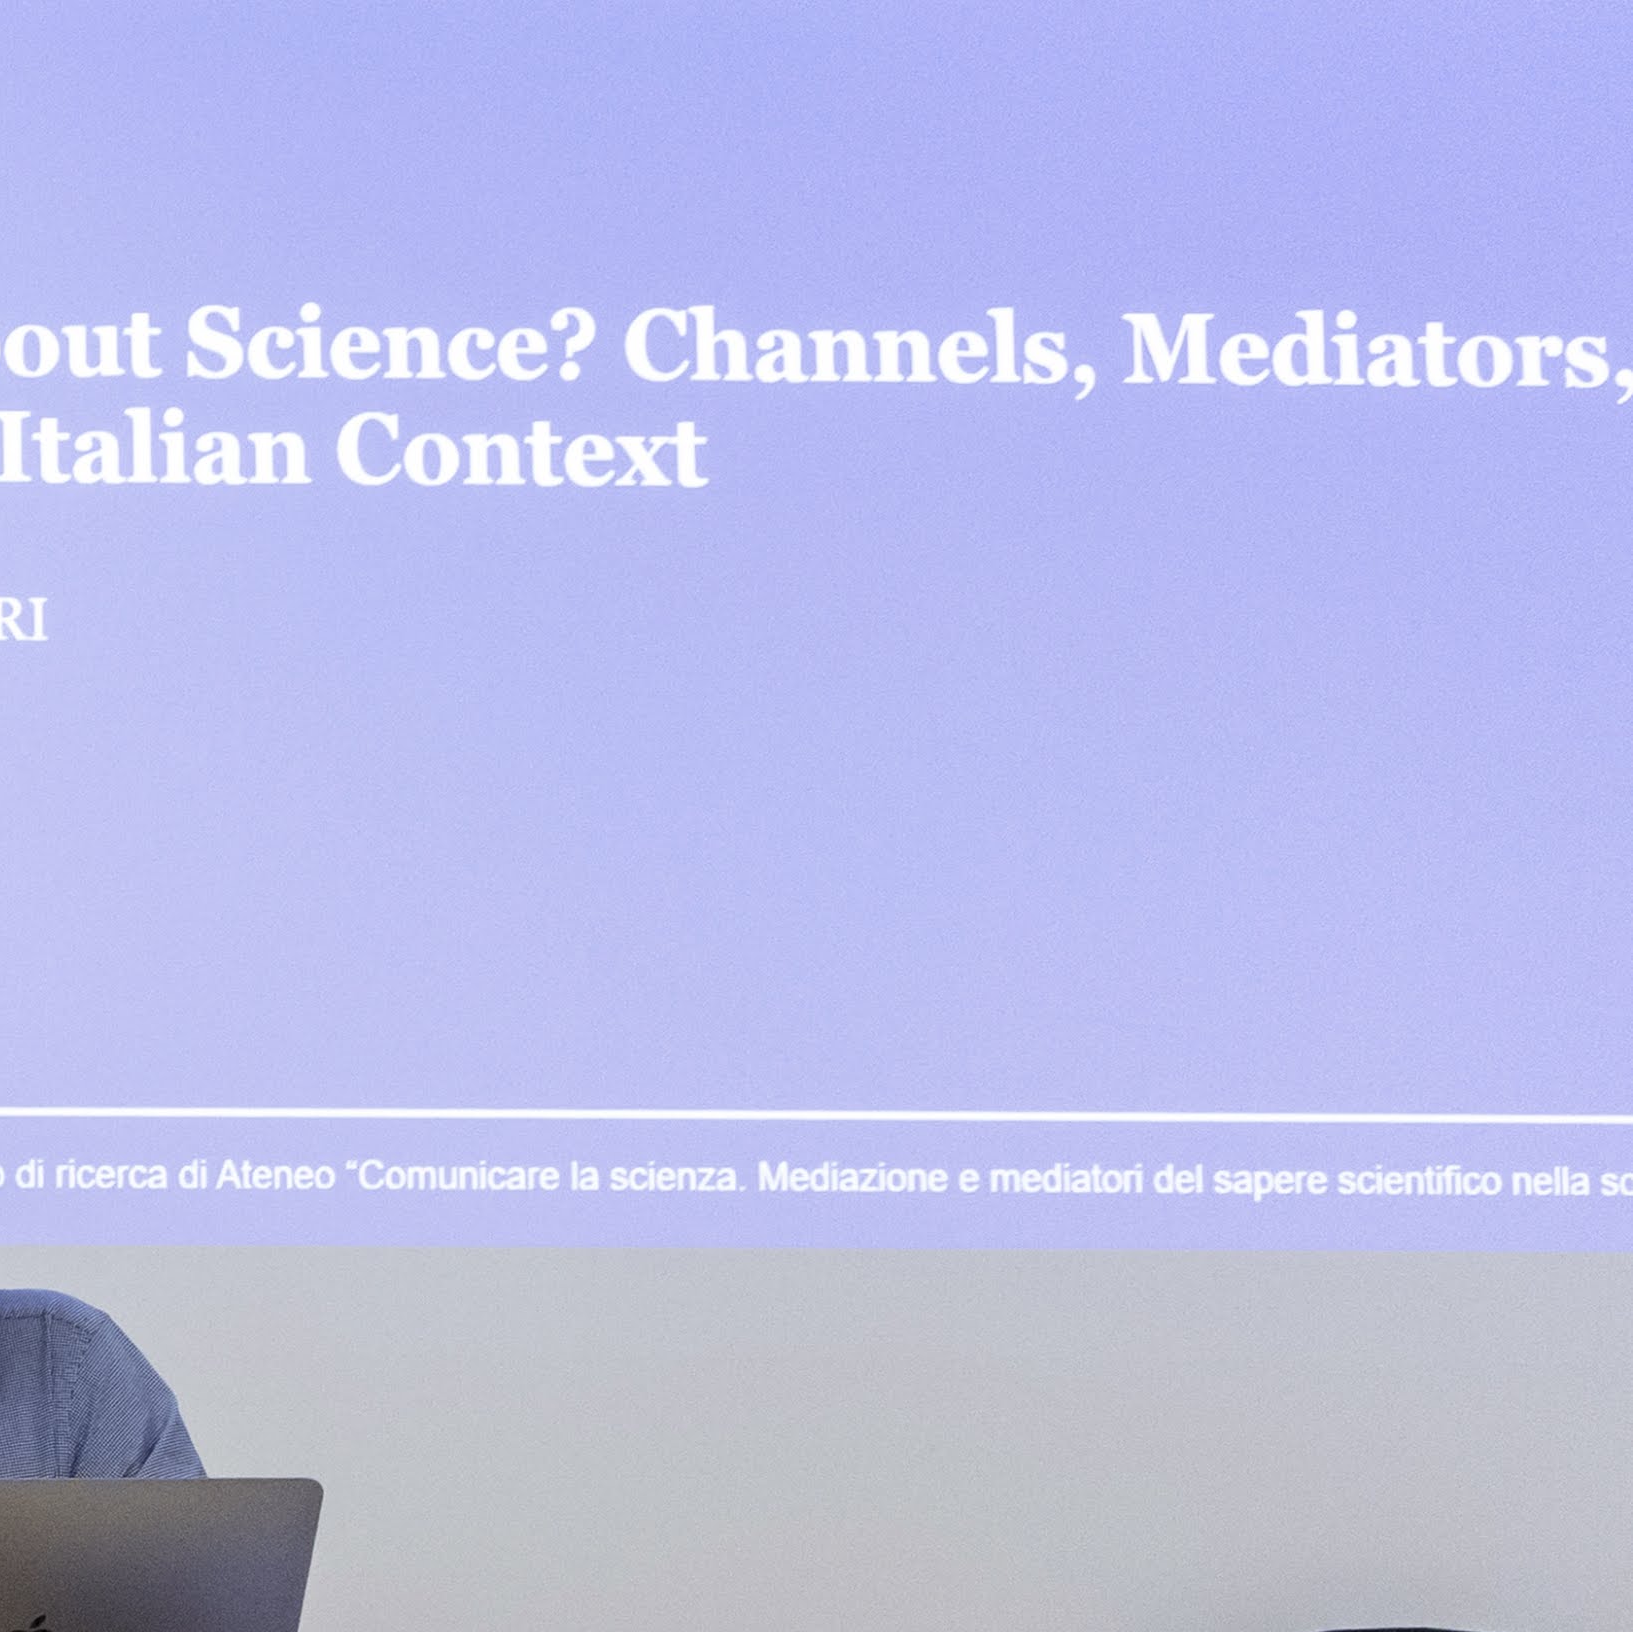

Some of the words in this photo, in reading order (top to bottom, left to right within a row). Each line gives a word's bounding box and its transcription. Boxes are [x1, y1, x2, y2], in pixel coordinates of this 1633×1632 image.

[187, 303, 597, 383] Science?
[625, 305, 1097, 402] Channels,
[1122, 310, 1633, 406] Mediators,
[337, 412, 710, 489] Context
[15, 1159, 46, 1190] di
[56, 1159, 169, 1190] ricerca
[179, 1160, 209, 1190] di
[216, 1159, 337, 1191] Ateneo
[572, 1161, 601, 1192] la
[611, 1161, 747, 1193] scienza.
[758, 1161, 950, 1194] Mediazione
[959, 1169, 981, 1194] e
[990, 1163, 1145, 1195] mediatori
[1154, 1164, 1205, 1195] del
[1214, 1170, 1329, 1204] sapere
[1338, 1165, 1504, 1197] scientifico
[1512, 1166, 1592, 1197] nella
